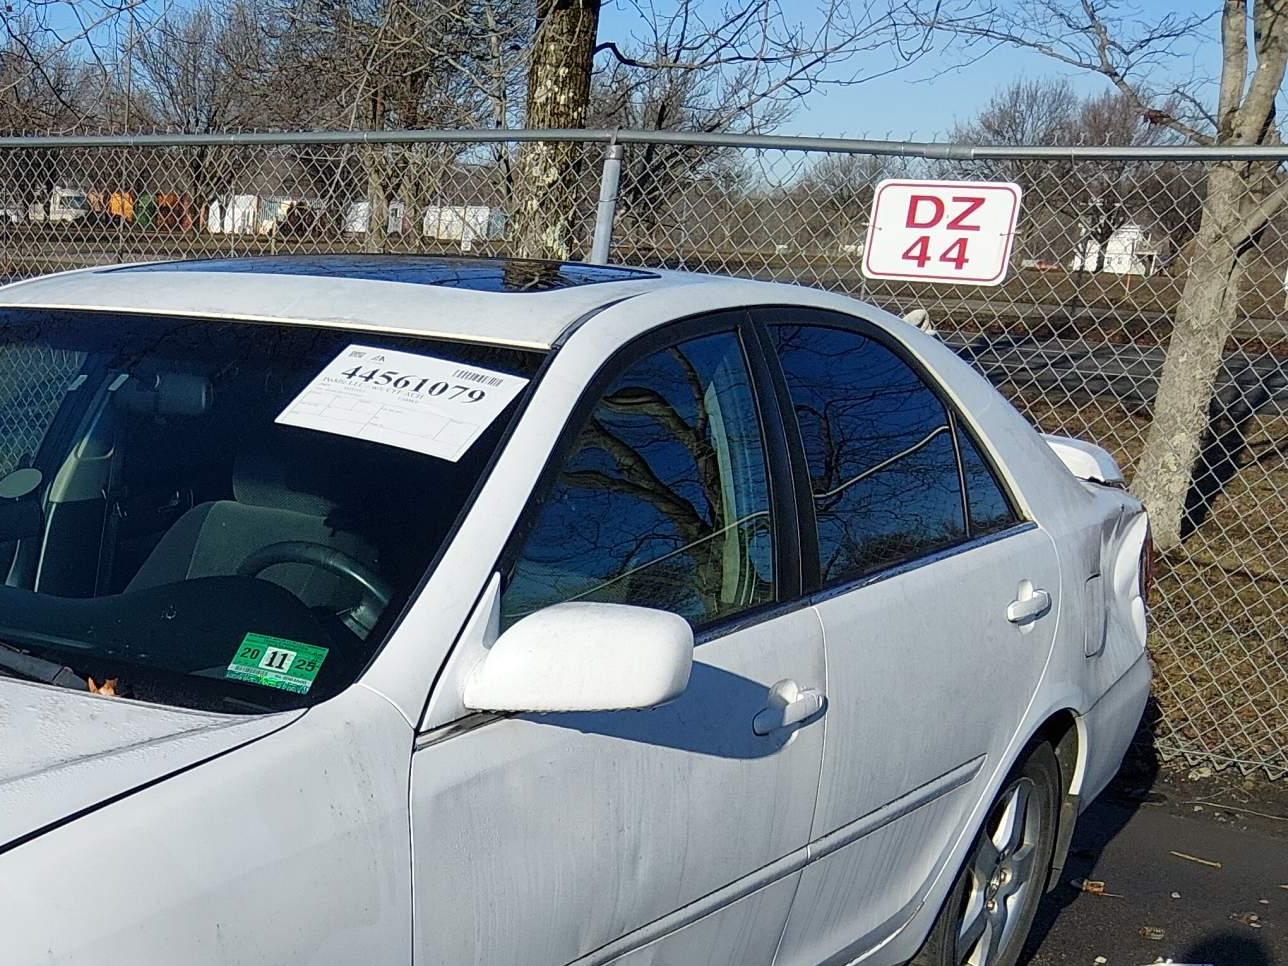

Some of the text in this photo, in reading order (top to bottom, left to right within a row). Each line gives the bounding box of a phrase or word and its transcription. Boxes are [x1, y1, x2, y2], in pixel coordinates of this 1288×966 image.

[905, 195, 986, 231] DZ
[901, 235, 970, 270] 44
[341, 365, 486, 403] 44561079
[240, 647, 260, 660] 20
[265, 650, 289, 670] 11
[295, 659, 316, 672] 25
